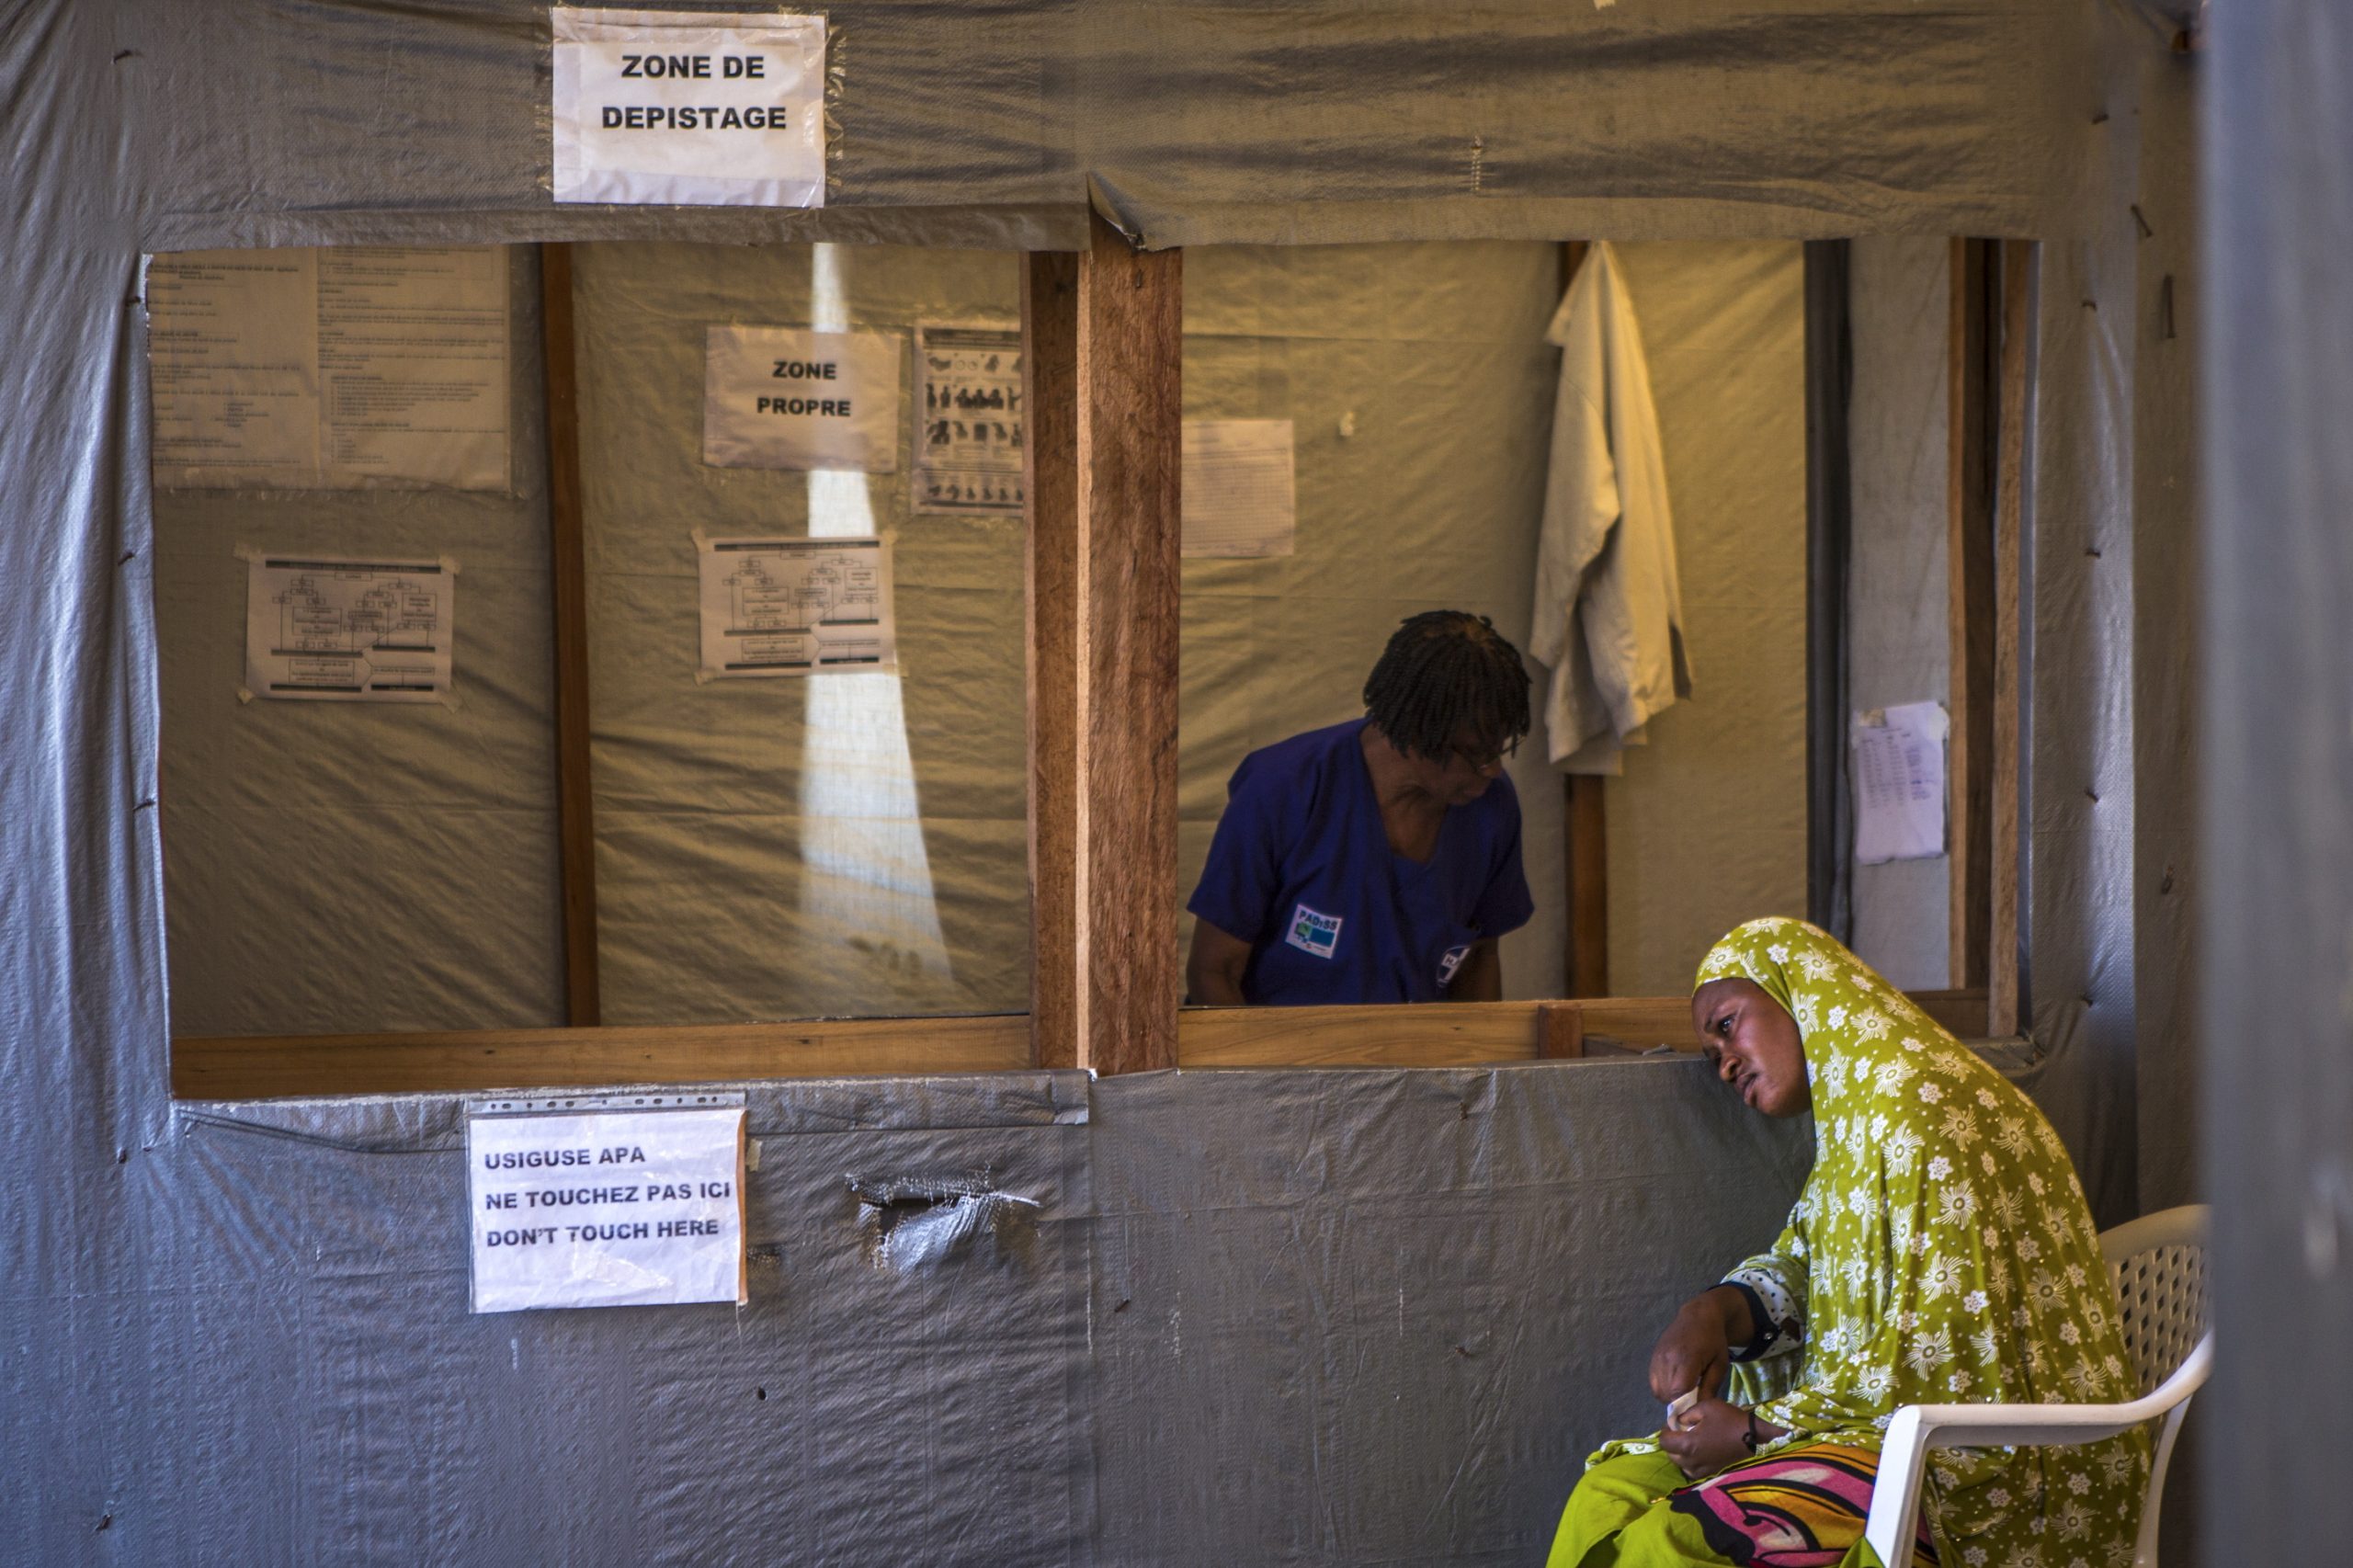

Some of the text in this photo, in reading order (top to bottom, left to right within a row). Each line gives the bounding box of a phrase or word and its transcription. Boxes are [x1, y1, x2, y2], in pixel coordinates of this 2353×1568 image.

[621, 55, 766, 79] ZONE DE
[602, 106, 787, 130] DEPISTAGE
[772, 360, 837, 381] ZONE
[756, 396, 851, 417] PROPRE
[484, 1146, 646, 1170] USIGUSE APA
[485, 1182, 731, 1210] NE TOUCHEZ PAS ICI
[565, 1222, 649, 1243] TOUCH
[657, 1219, 720, 1238] HERE
